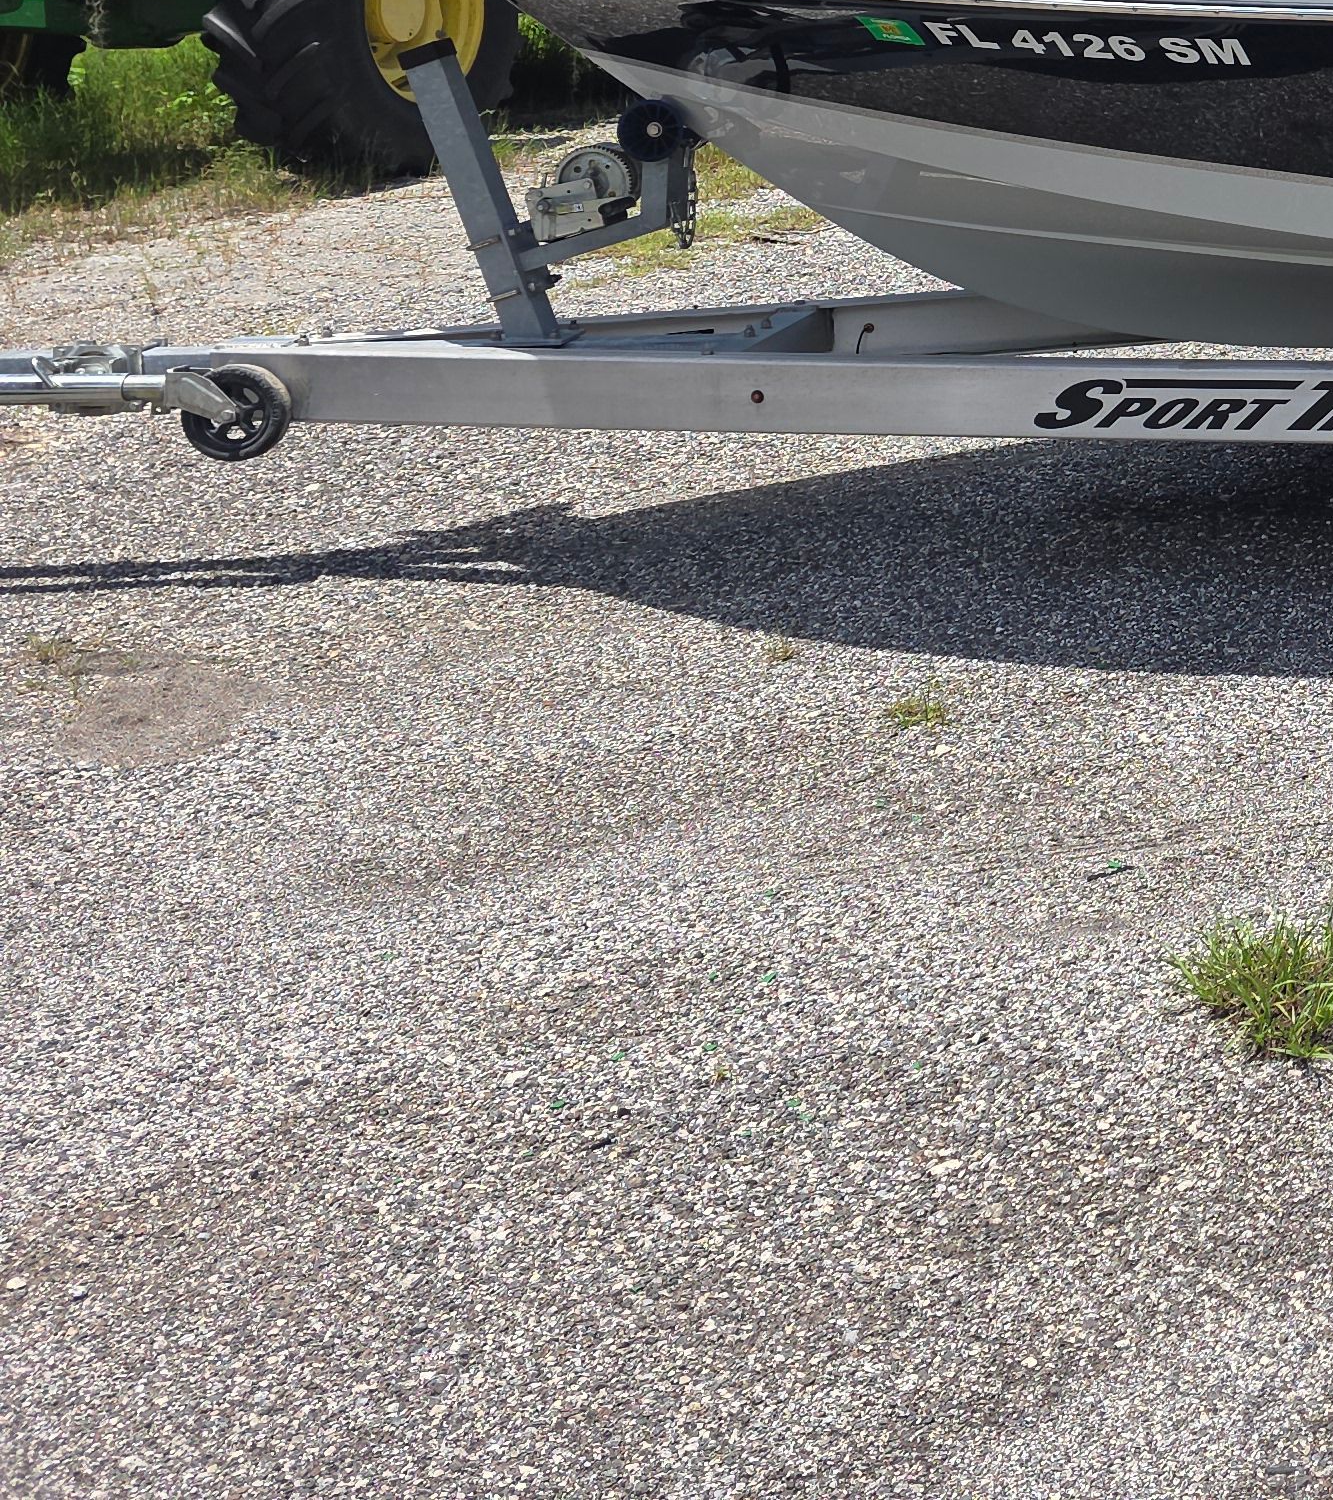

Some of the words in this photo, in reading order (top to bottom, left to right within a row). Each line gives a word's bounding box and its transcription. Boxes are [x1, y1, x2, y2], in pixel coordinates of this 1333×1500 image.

[922, 21, 1001, 50] FL
[1011, 29, 1146, 62] 4126
[1158, 36, 1252, 66] SM
[1033, 378, 1305, 430] SPORT
